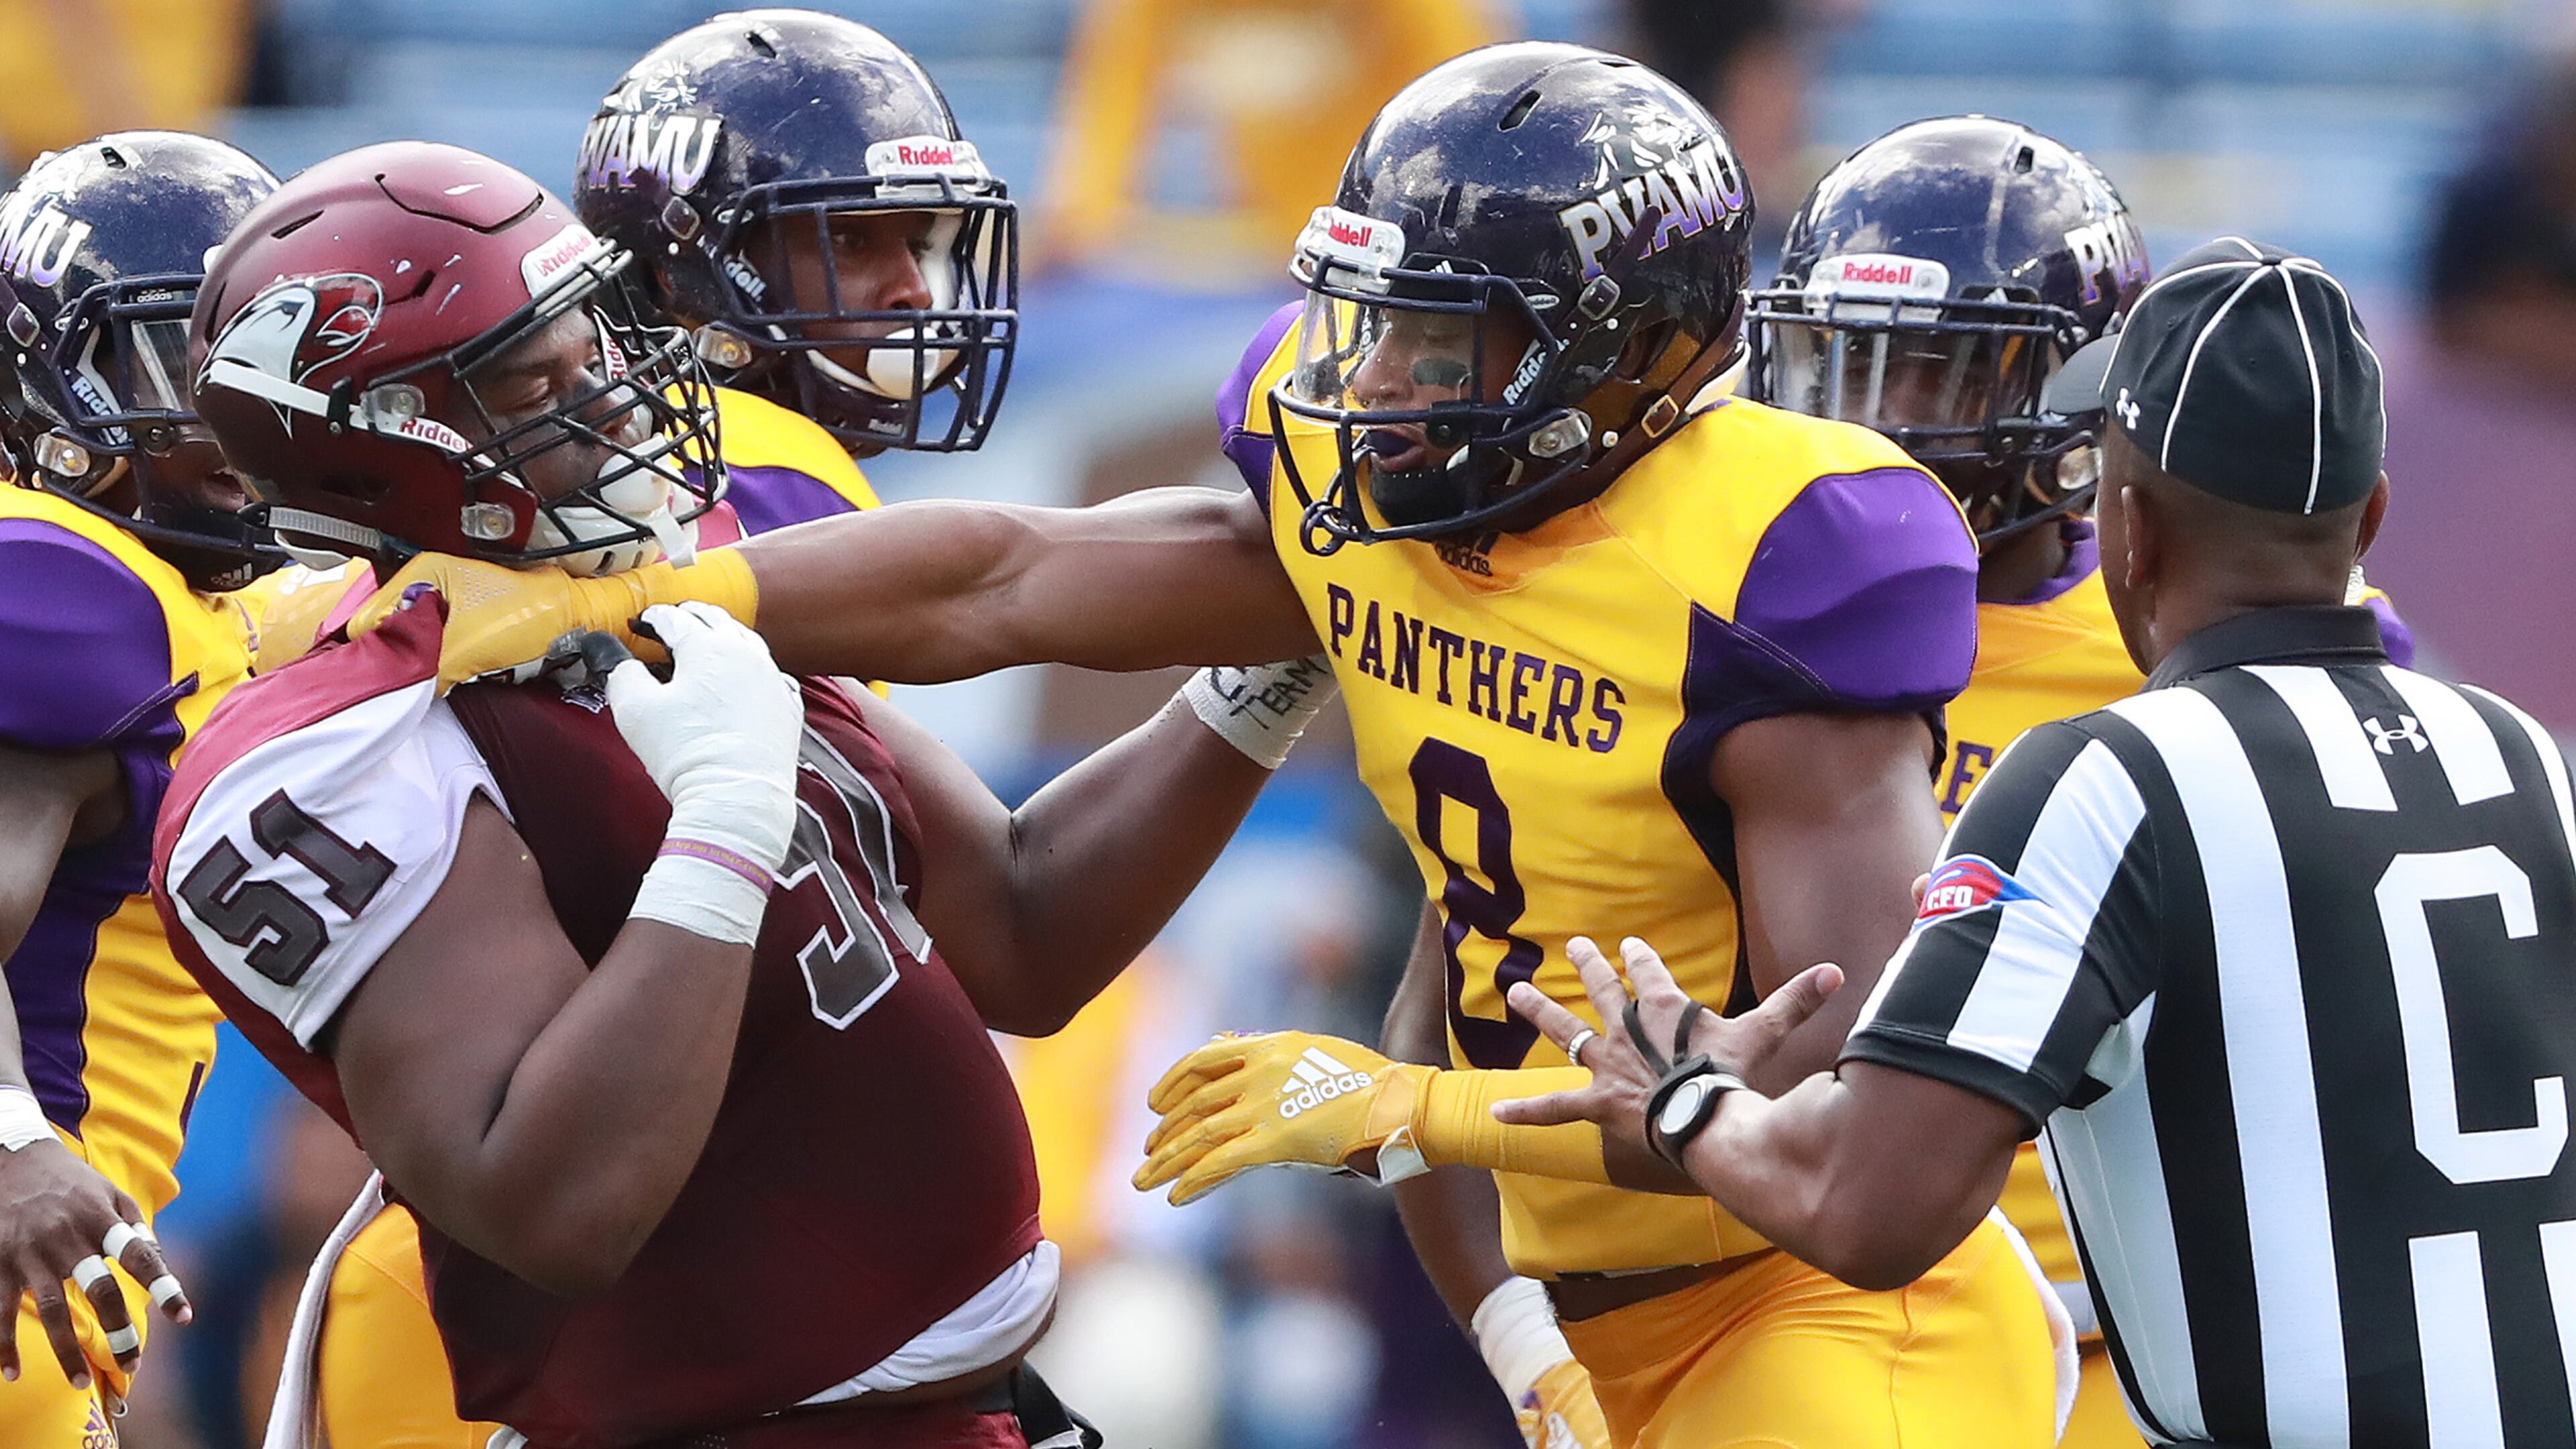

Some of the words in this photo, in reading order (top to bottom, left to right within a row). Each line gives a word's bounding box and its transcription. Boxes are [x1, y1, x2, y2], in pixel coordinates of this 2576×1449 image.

[1559, 140, 1744, 284] PVAMU
[1843, 262, 1913, 284] Riddell
[1327, 582, 1626, 753] PANTHERS
[176, 788, 397, 986] 51
[1408, 737, 1544, 1069] 8
[1279, 1071, 1373, 1118] adidas
[2374, 845, 2569, 1184] C
